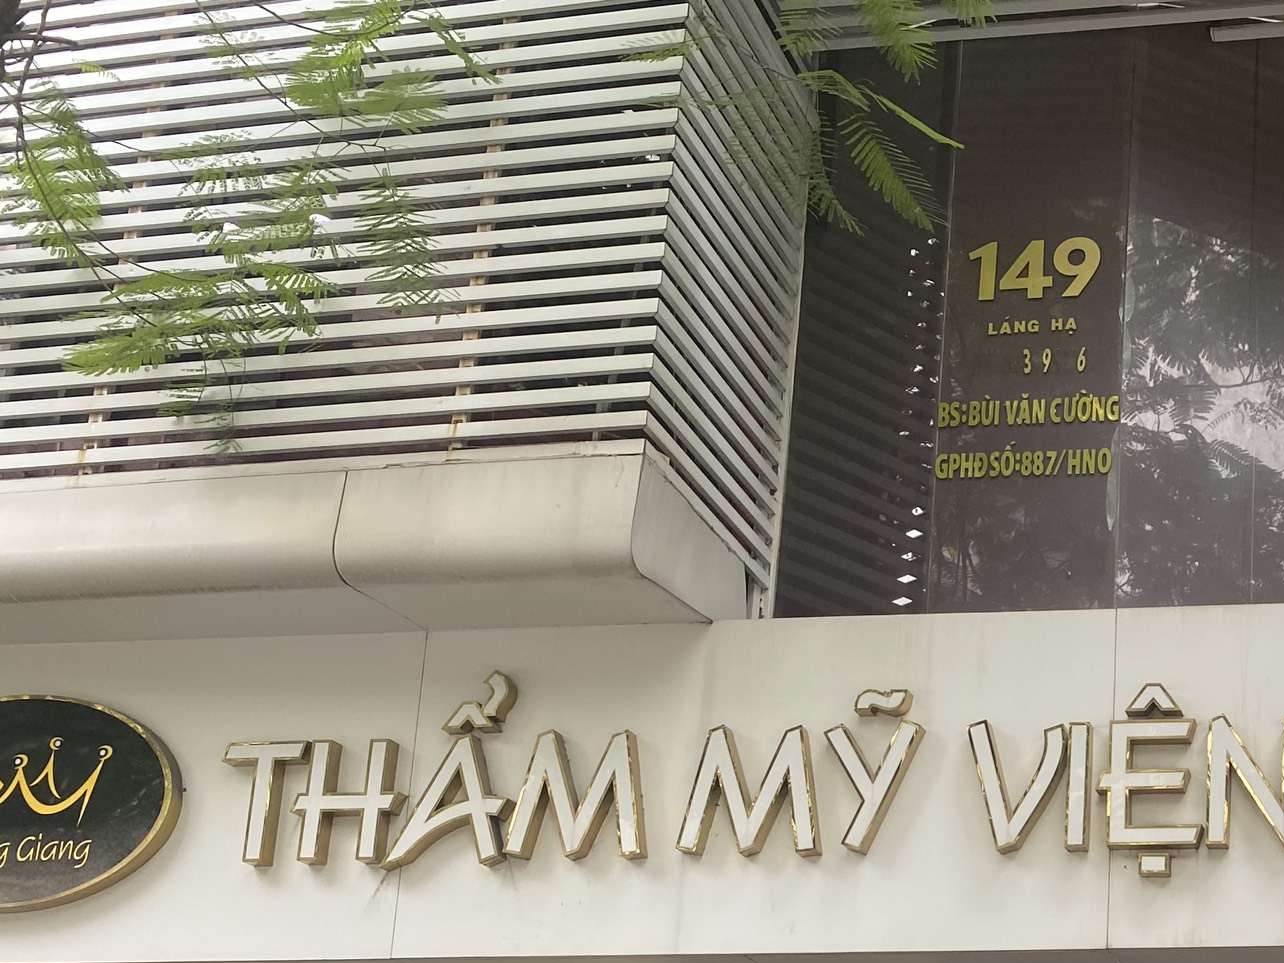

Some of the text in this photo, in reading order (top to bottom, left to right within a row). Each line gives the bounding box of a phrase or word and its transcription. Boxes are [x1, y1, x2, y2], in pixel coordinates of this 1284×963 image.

[968, 236, 1101, 301] 149
[988, 316, 1078, 335] LÁNG HẠ
[1005, 392, 1046, 425] VĂN
[1050, 388, 1120, 424] CƯỜNG
[221, 669, 648, 872] THẨM
[675, 688, 926, 858] MỸ
[16, 833, 92, 869] Giang
